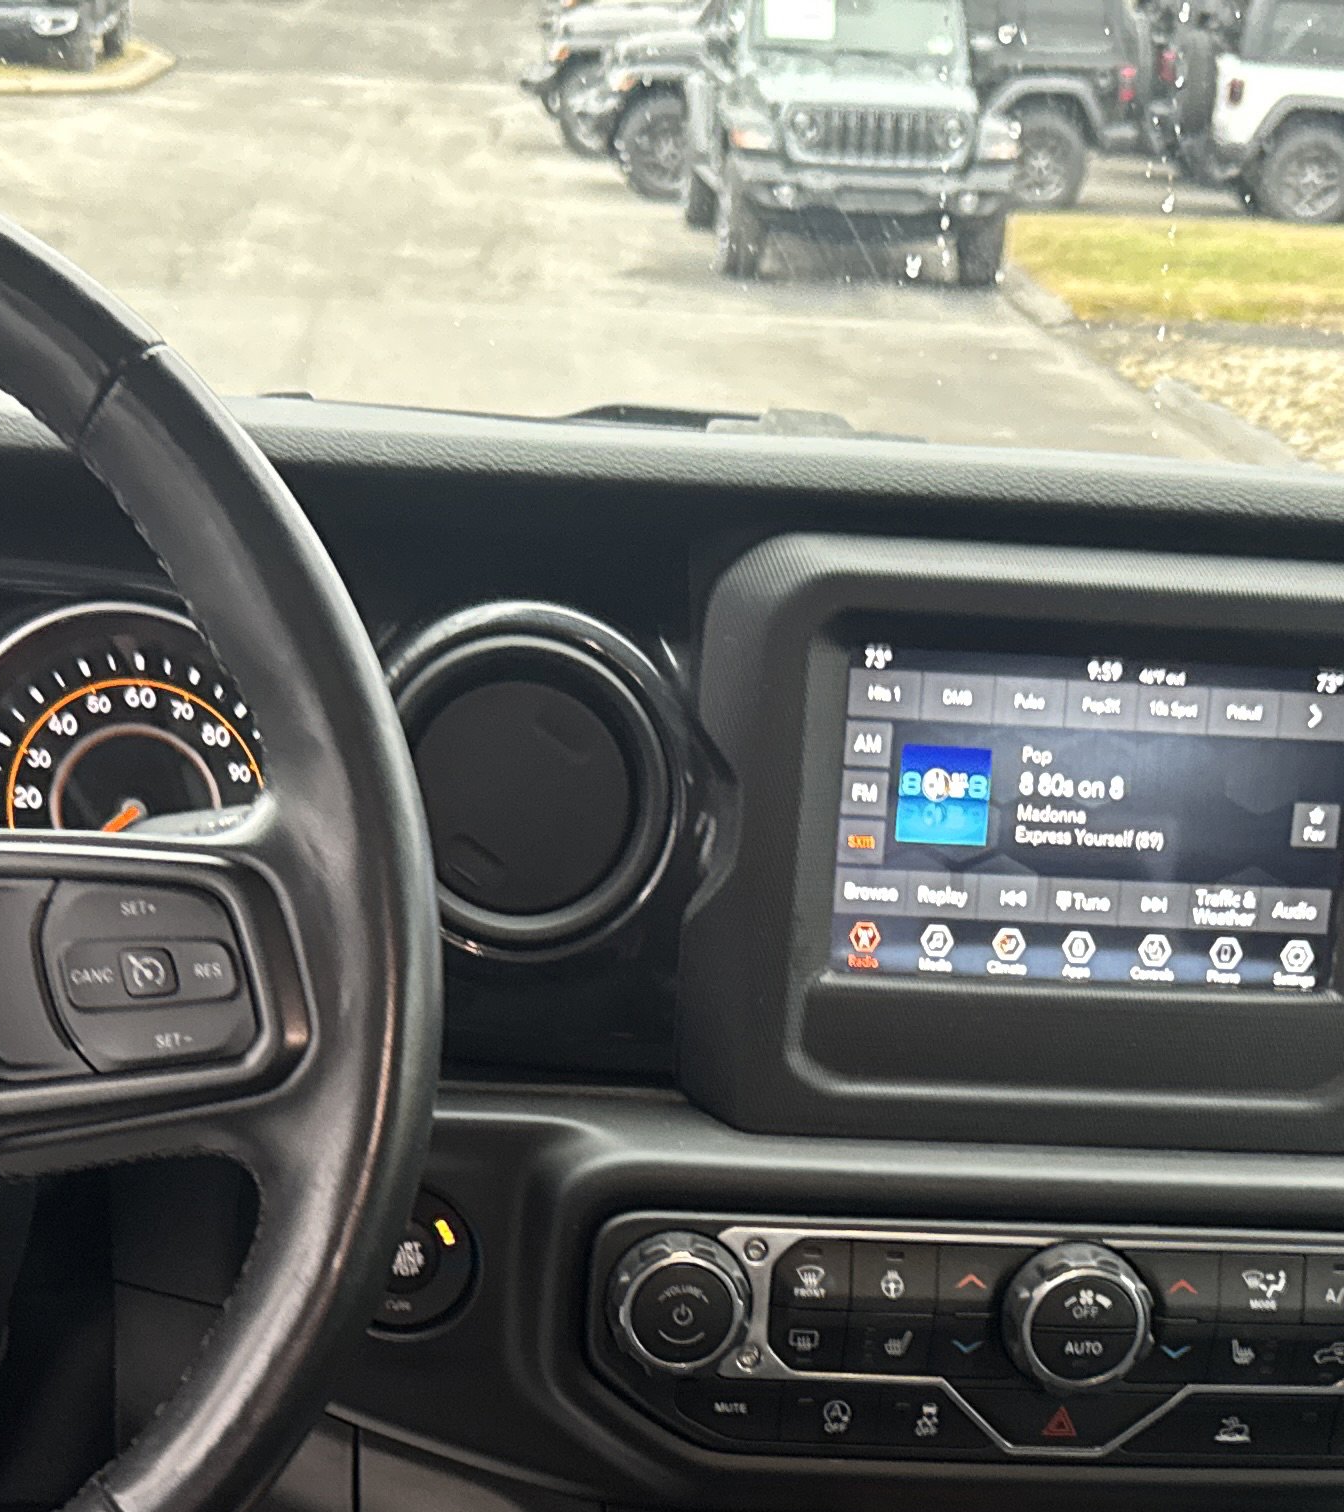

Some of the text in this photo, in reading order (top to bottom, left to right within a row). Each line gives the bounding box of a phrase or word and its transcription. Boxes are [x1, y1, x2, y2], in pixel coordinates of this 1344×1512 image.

[1087, 660, 1123, 682] 9:59
[86, 693, 111, 714] 50
[124, 688, 156, 708] 60
[171, 697, 194, 720] 70
[48, 713, 78, 736] 40
[201, 723, 230, 748] 80
[854, 734, 882, 753] AM
[27, 749, 52, 769] 30
[1022, 744, 1052, 767] Pop
[228, 763, 251, 783] 90
[852, 782, 878, 802] FM
[1019, 771, 1124, 800] 8 80s on 8
[14, 786, 42, 809] 20
[1017, 803, 1087, 824] Madonna
[1015, 825, 1164, 851] Express Yourself (89)
[1303, 826, 1326, 842] Fav
[844, 881, 898, 902] Browse
[917, 885, 968, 908] Replay
[1195, 888, 1256, 910] Traffic &
[1073, 892, 1111, 912] Tune
[1272, 901, 1317, 921] Audio
[1192, 908, 1255, 927] Weather
[70, 968, 114, 985] CANC
[193, 962, 222, 979] RES
[794, 1287, 826, 1298] FRONT
[1072, 1305, 1099, 1319] OFF
[1064, 1341, 1104, 1356] AUTO
[714, 1402, 747, 1413] MUTE
